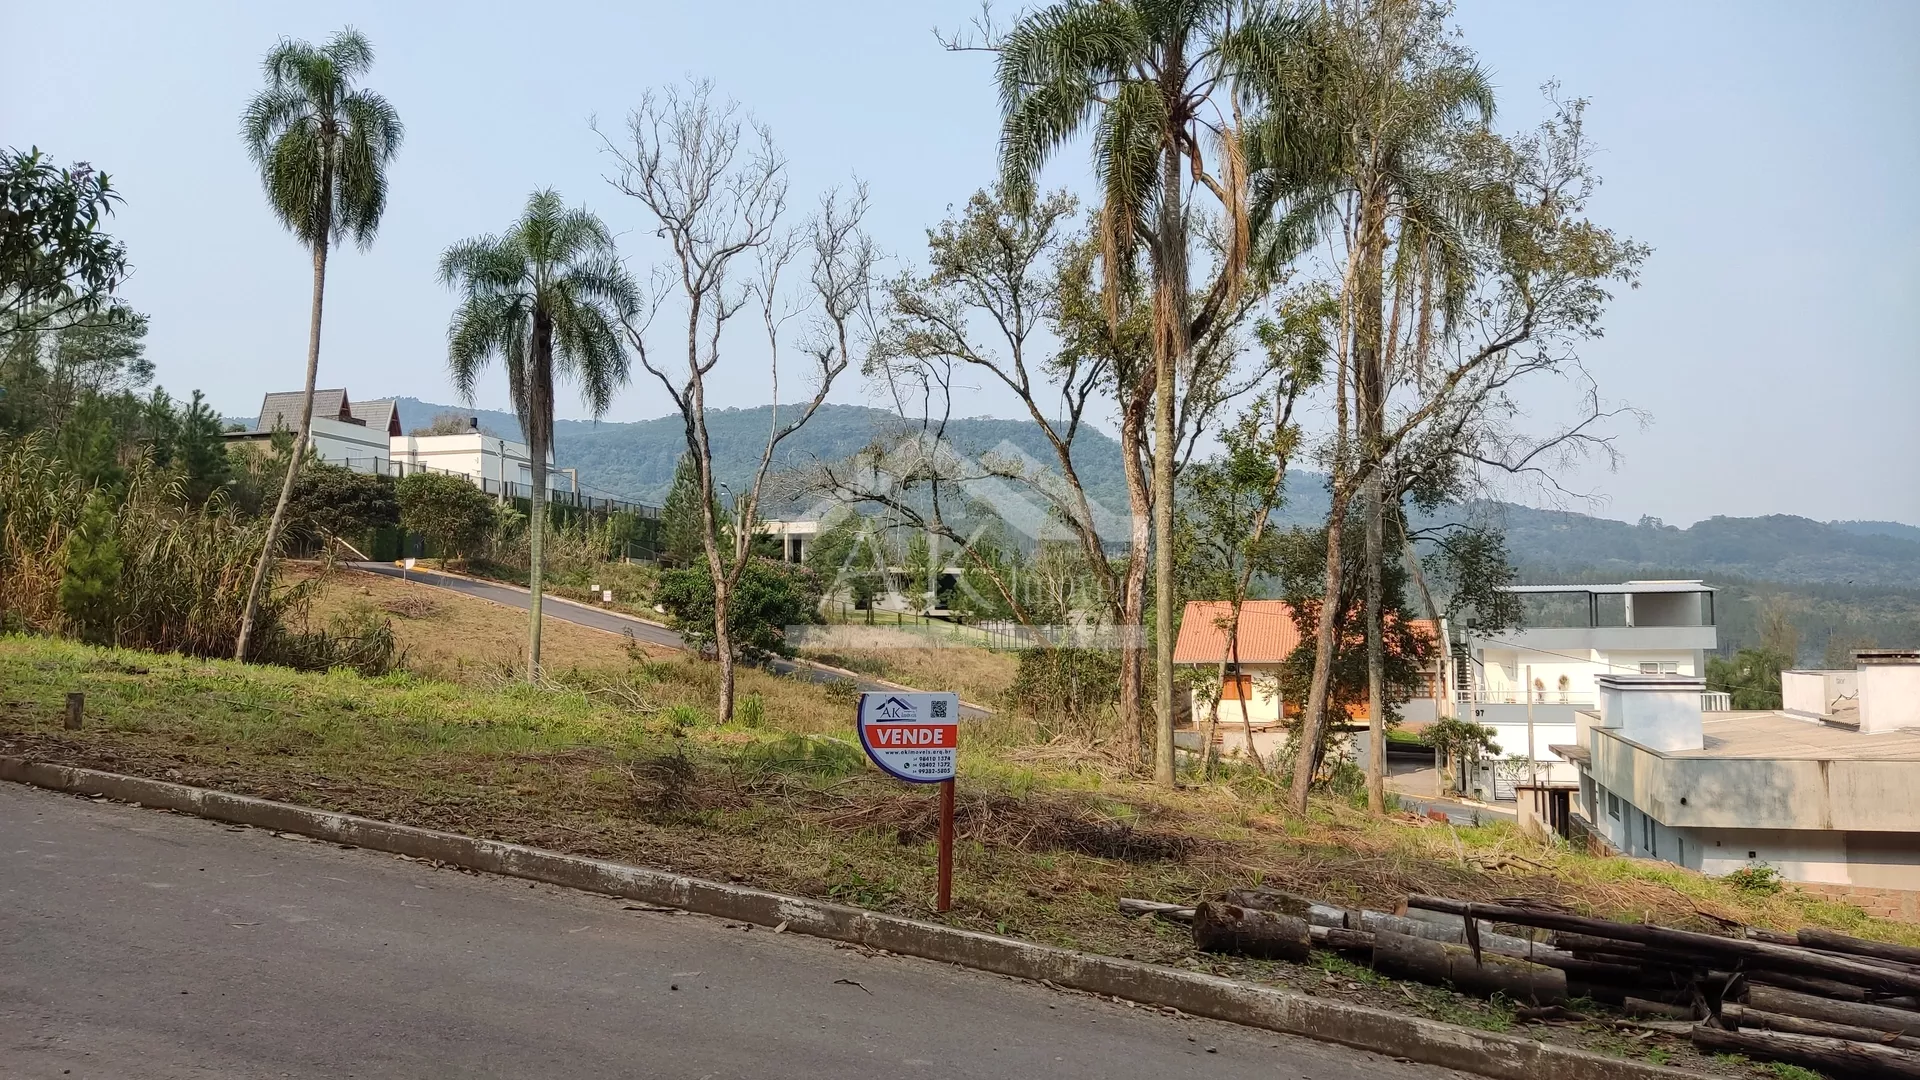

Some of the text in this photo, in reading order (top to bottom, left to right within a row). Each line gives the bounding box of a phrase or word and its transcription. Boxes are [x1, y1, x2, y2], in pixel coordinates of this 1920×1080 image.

[881, 707, 900, 718] AK
[1475, 709, 1485, 717] 97
[876, 728, 943, 745] VENDE
